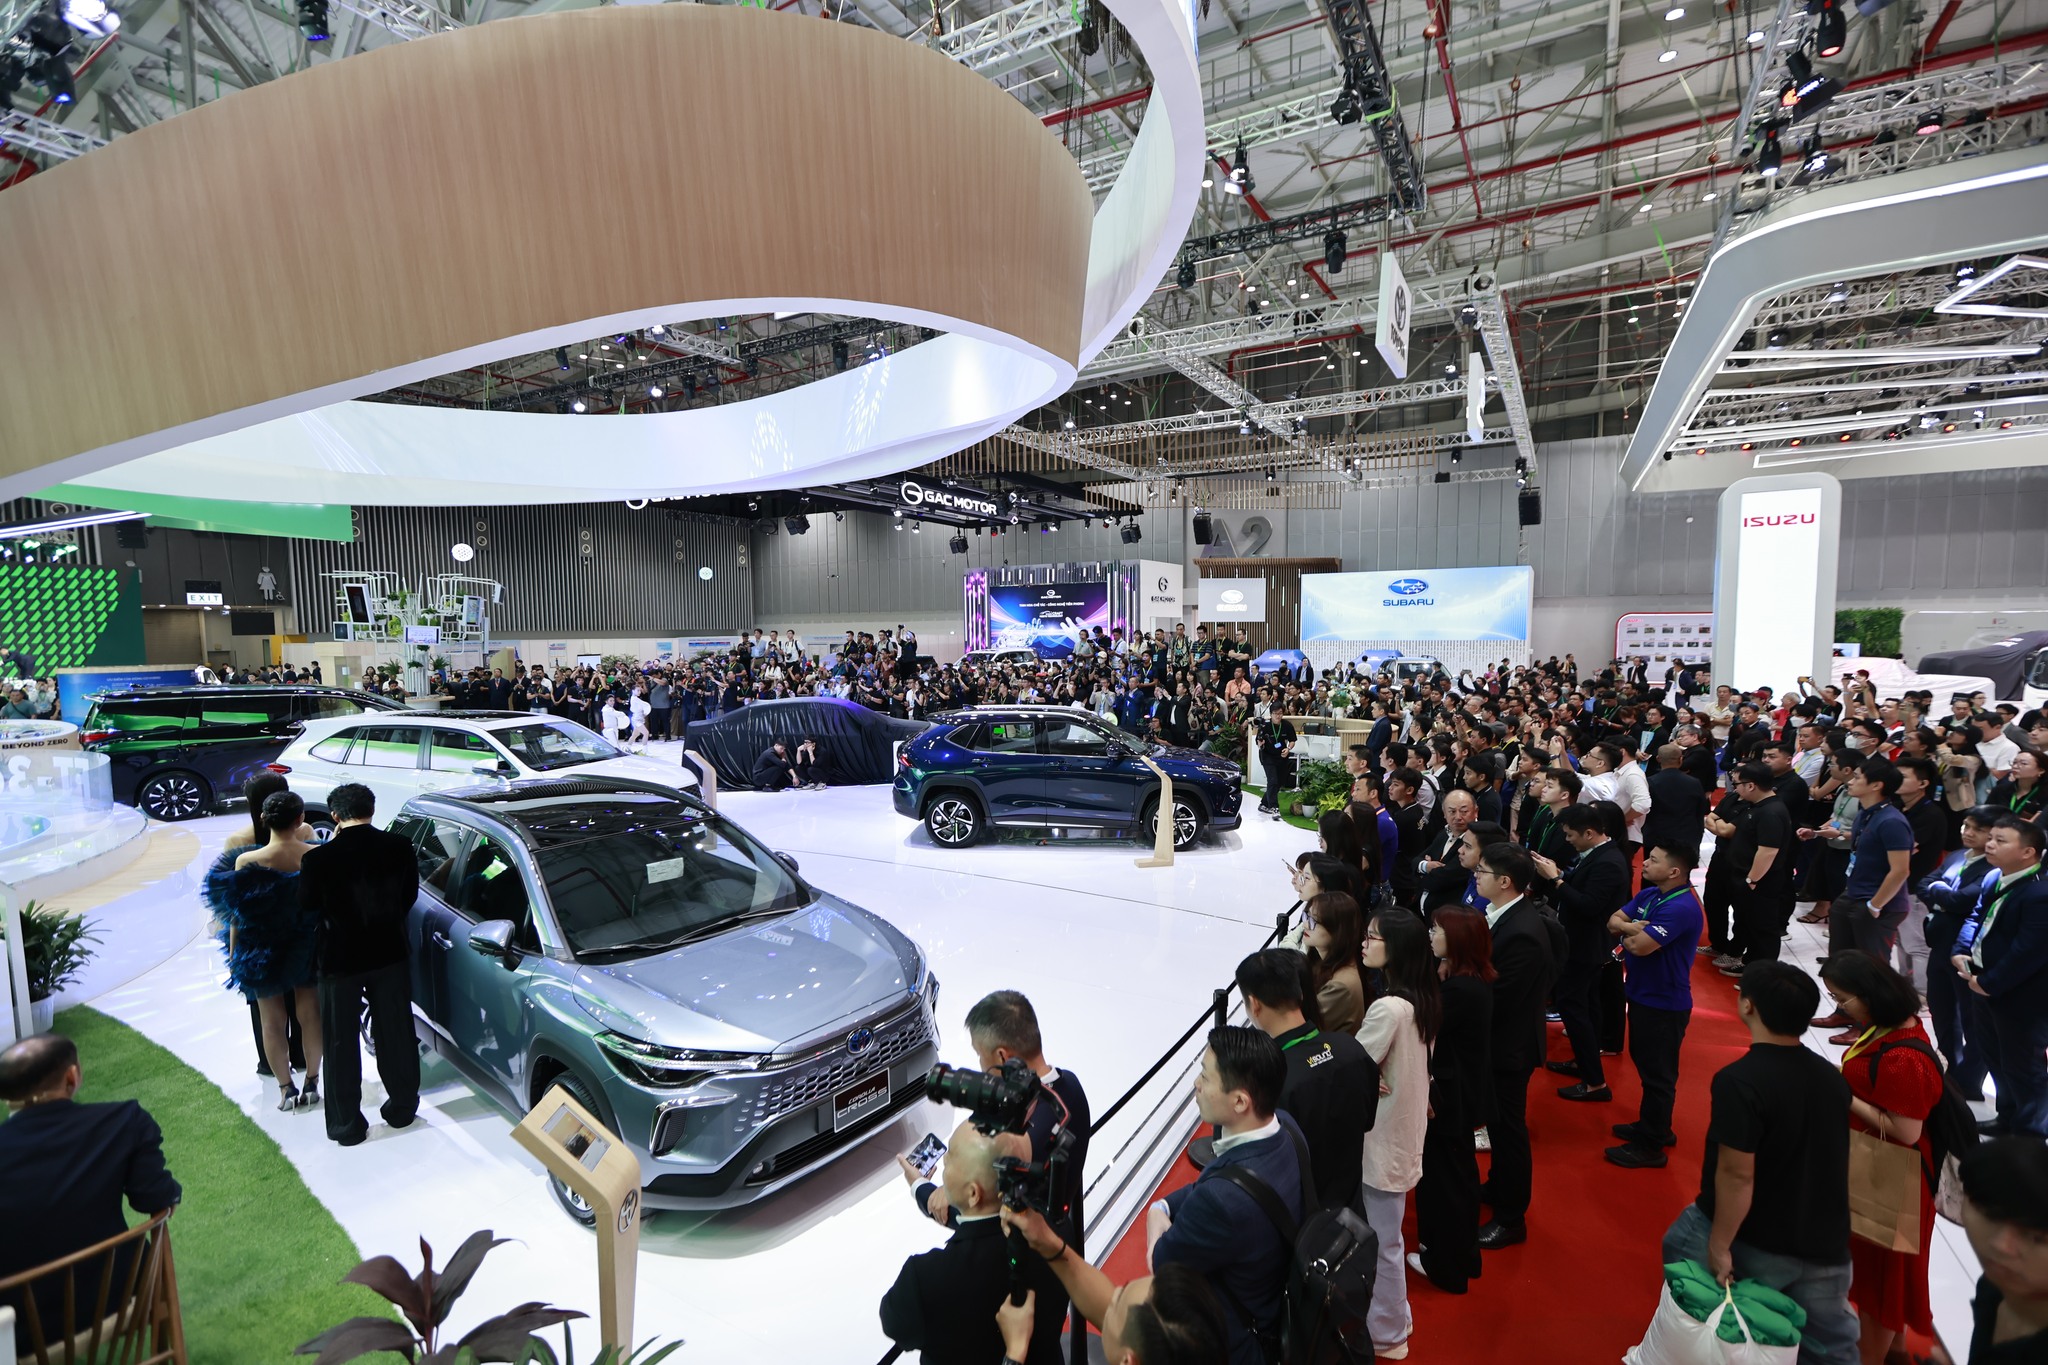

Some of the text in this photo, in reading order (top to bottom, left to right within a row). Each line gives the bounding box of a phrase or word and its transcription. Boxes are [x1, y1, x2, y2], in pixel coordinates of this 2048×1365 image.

[924, 491, 997, 515] GAC MOTOR
[1743, 513, 1815, 528] ISUZU
[1200, 515, 1273, 558] A2
[190, 594, 219, 602] EXIT
[1382, 598, 1434, 607] SUBARU
[2, 738, 68, 750] BEYOND ZERO
[837, 1086, 887, 1118] CROSS
[848, 1086, 876, 1104] COROLLA
